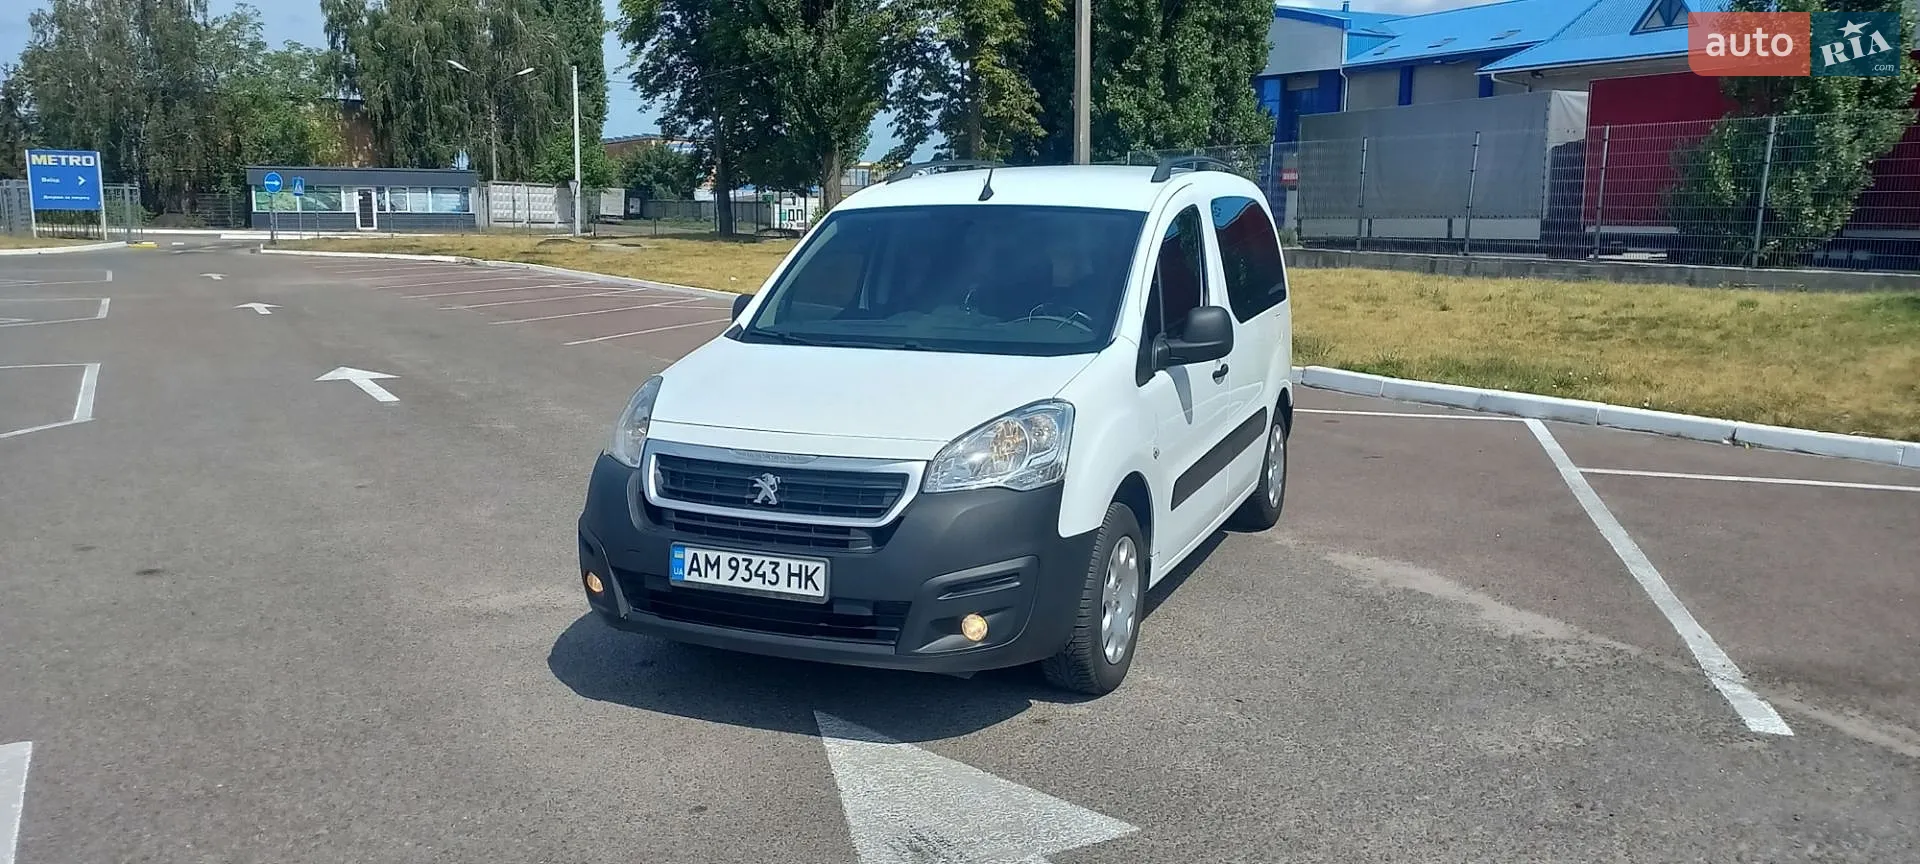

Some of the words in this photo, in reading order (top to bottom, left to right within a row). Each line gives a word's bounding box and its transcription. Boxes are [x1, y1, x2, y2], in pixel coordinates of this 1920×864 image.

[31, 154, 95, 167] METRO
[673, 567, 684, 576] UA
[687, 552, 721, 580] AM
[727, 557, 780, 586] 9343
[786, 563, 821, 591] HK
